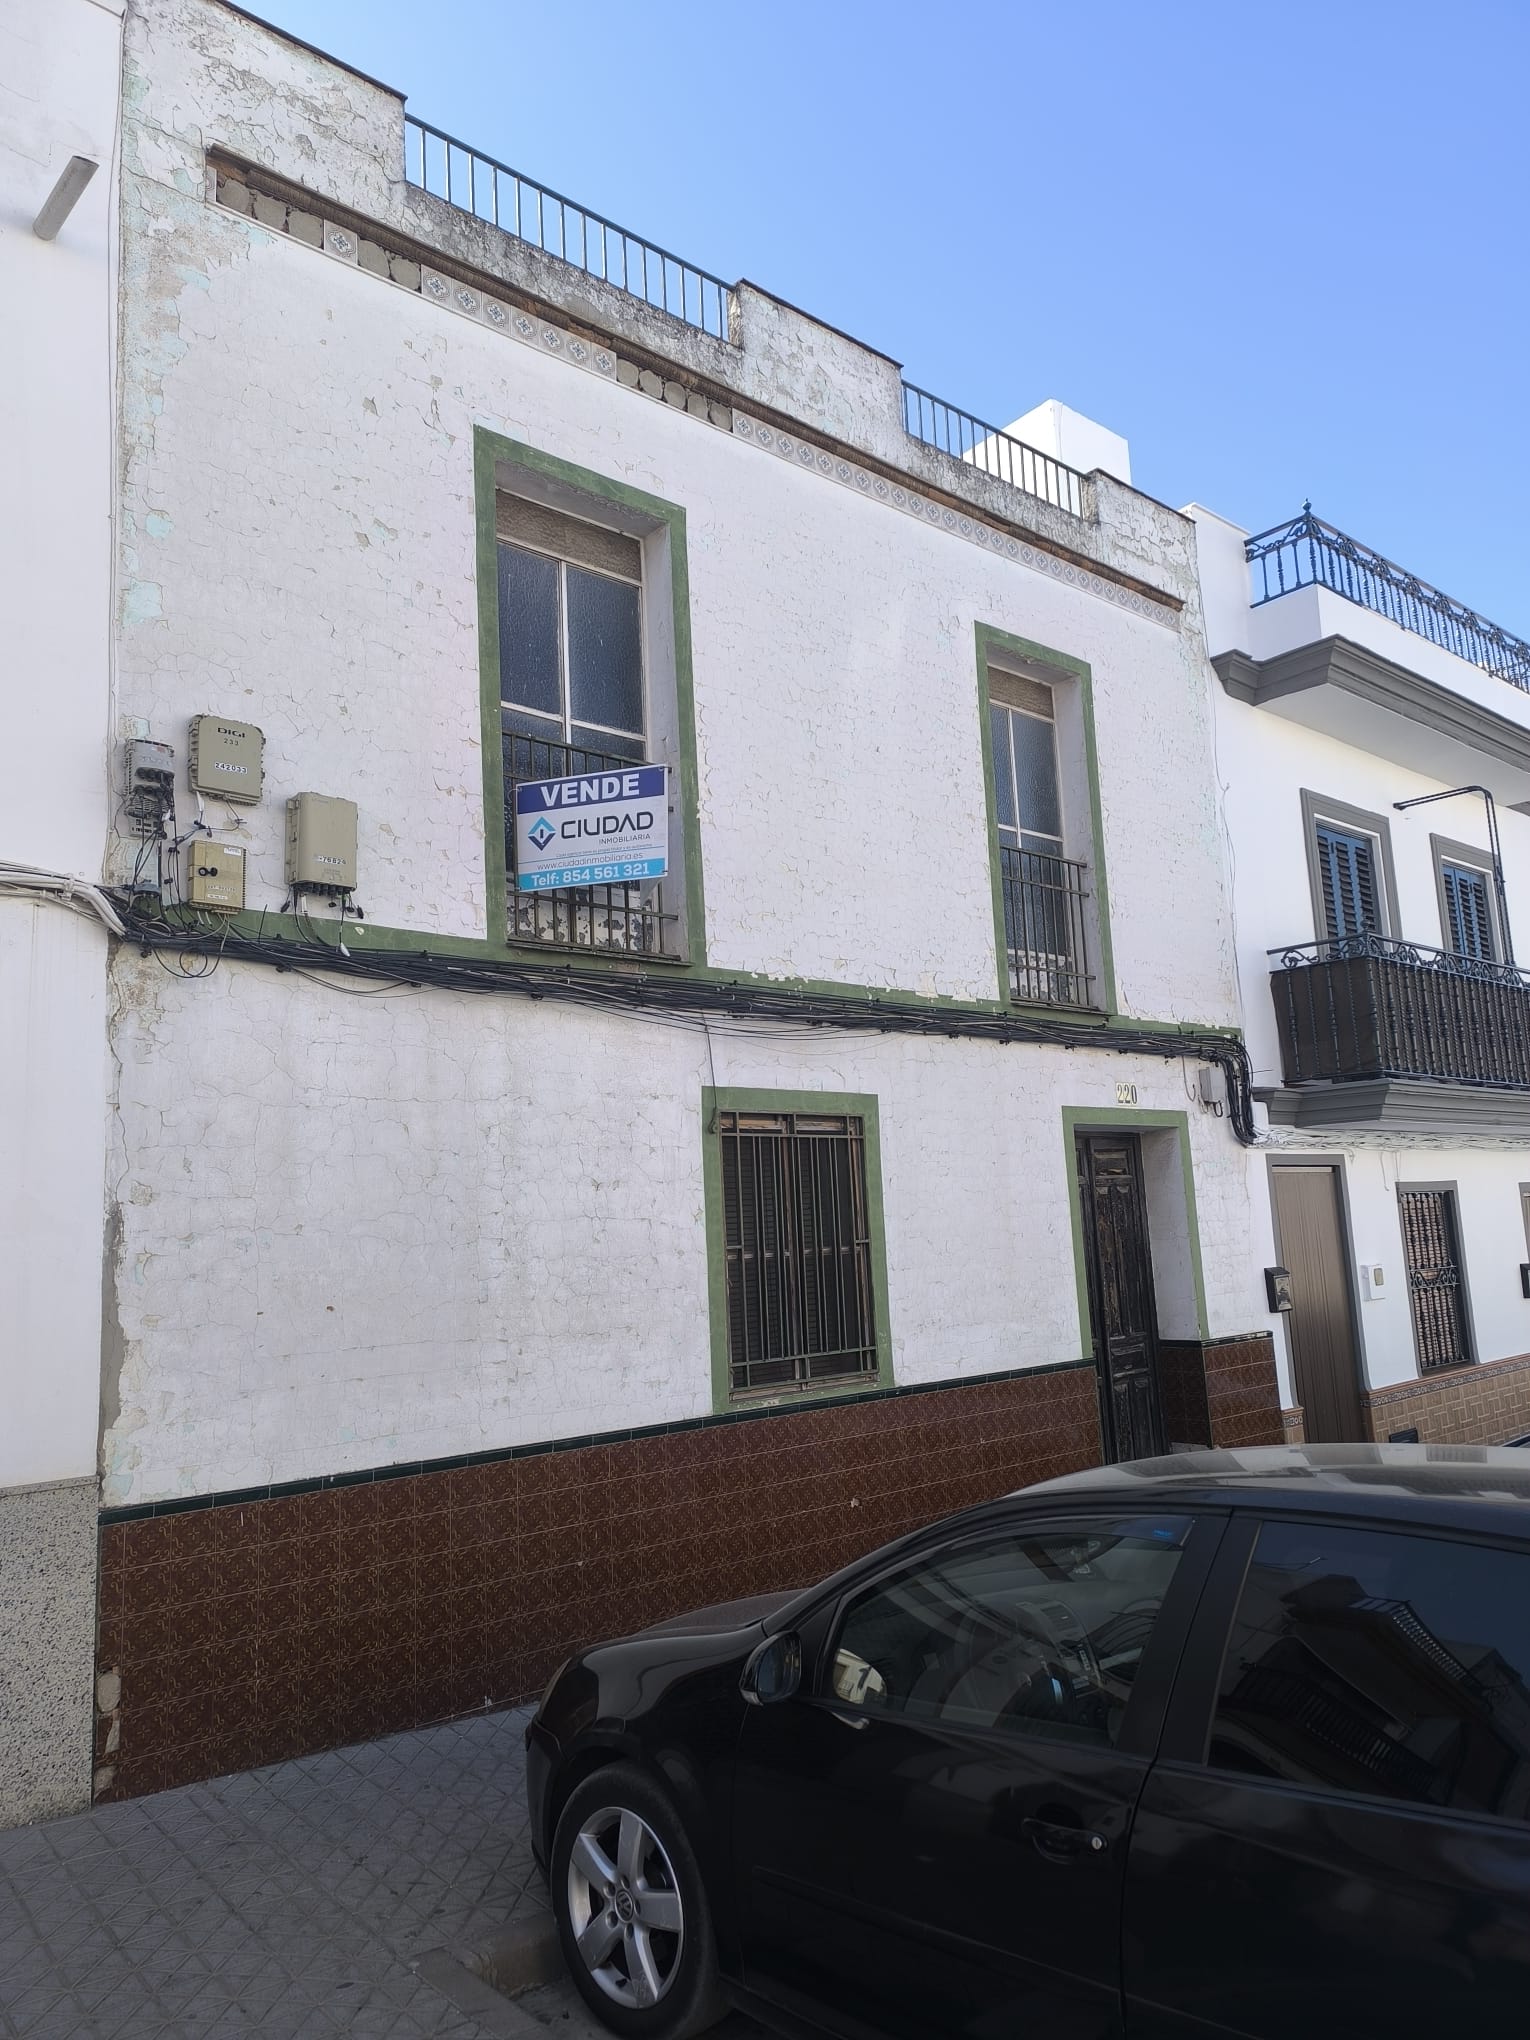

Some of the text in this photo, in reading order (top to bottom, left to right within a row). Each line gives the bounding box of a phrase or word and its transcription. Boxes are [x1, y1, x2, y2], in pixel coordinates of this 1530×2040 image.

[217, 727, 245, 738] DIGI
[540, 773, 640, 807] VENDE
[561, 811, 654, 839] CIUDAD
[598, 833, 651, 845] INMOBILIARIA
[537, 853, 643, 870] www.ciudadinmobiliaria.es
[531, 862, 650, 887] Telf: 854 561 321
[1117, 1084, 1138, 1104] 220
